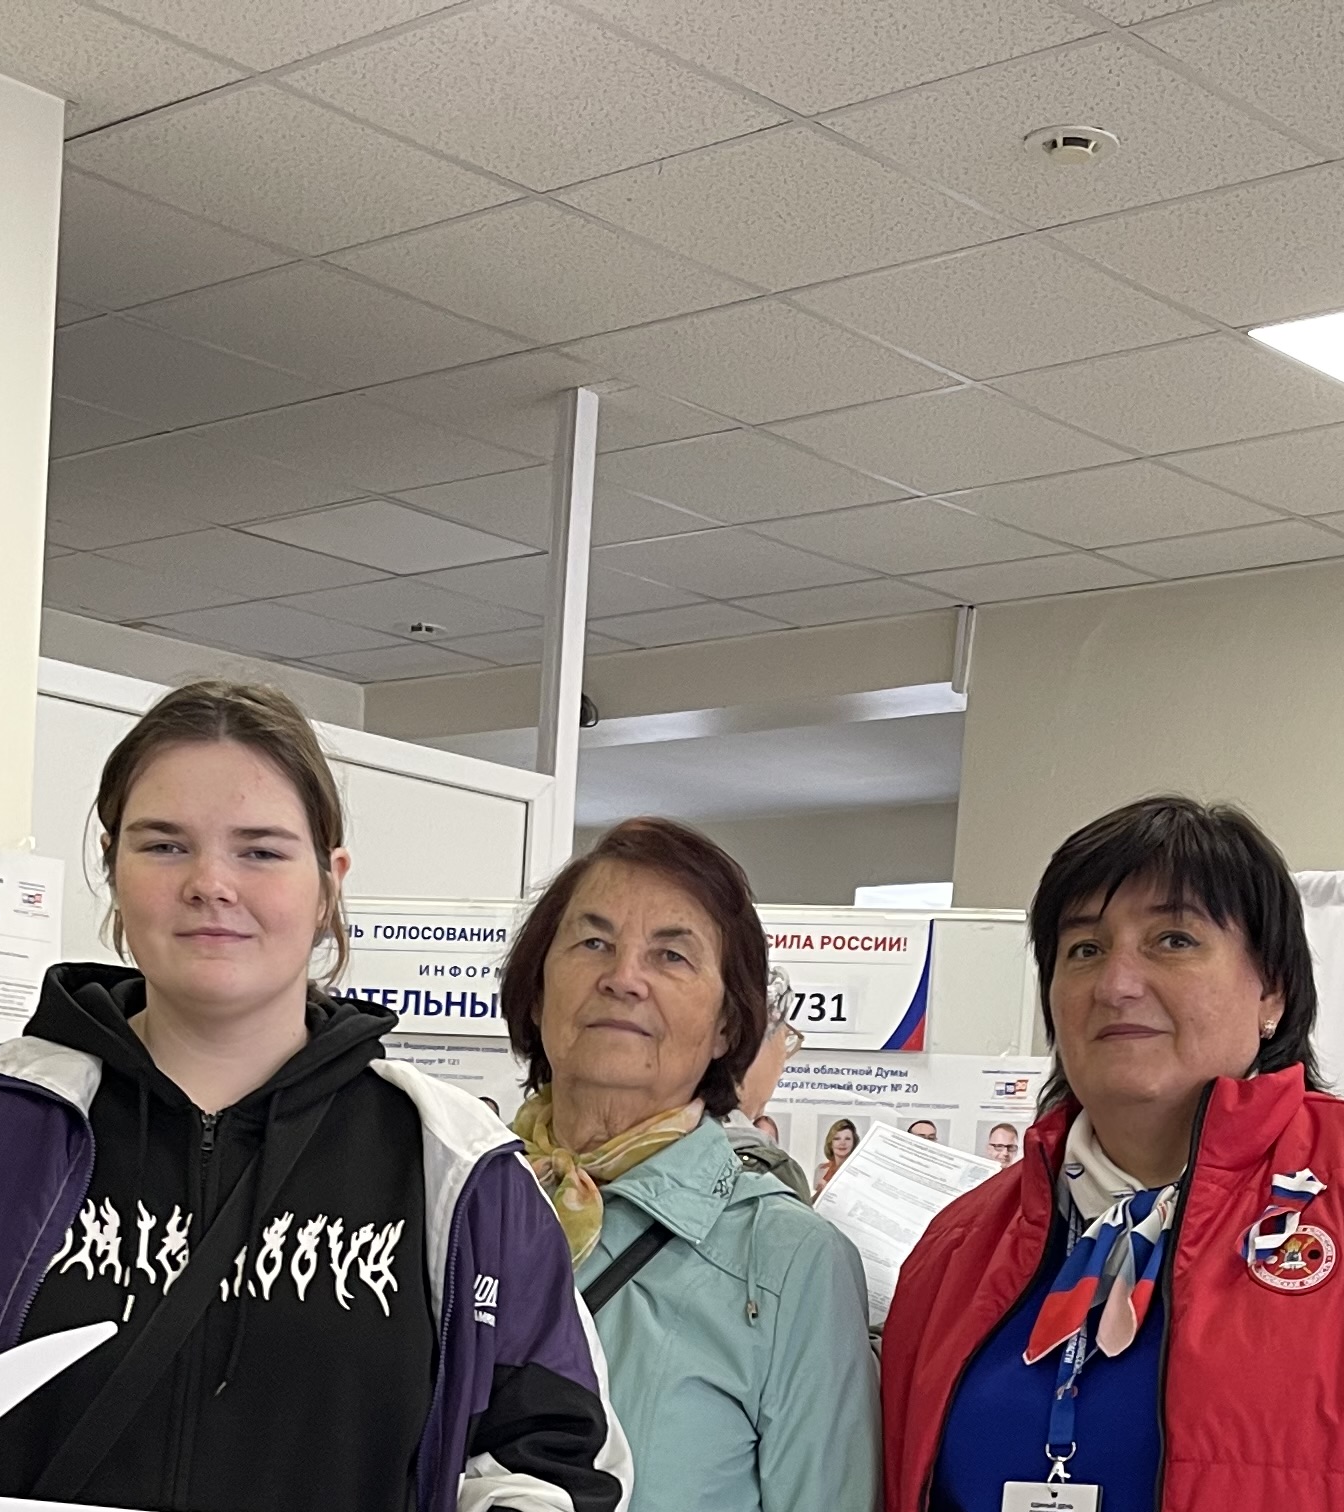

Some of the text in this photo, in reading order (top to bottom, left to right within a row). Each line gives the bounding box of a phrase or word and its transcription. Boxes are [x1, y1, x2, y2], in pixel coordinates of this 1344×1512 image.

[345, 924, 506, 942] НЬ ГОЛОСОВАНИЯ
[766, 933, 908, 952] СИЛА РОССИИ!
[784, 1064, 908, 1080] ской областной Думы
[778, 1077, 919, 1095] бирательный округ № 20
